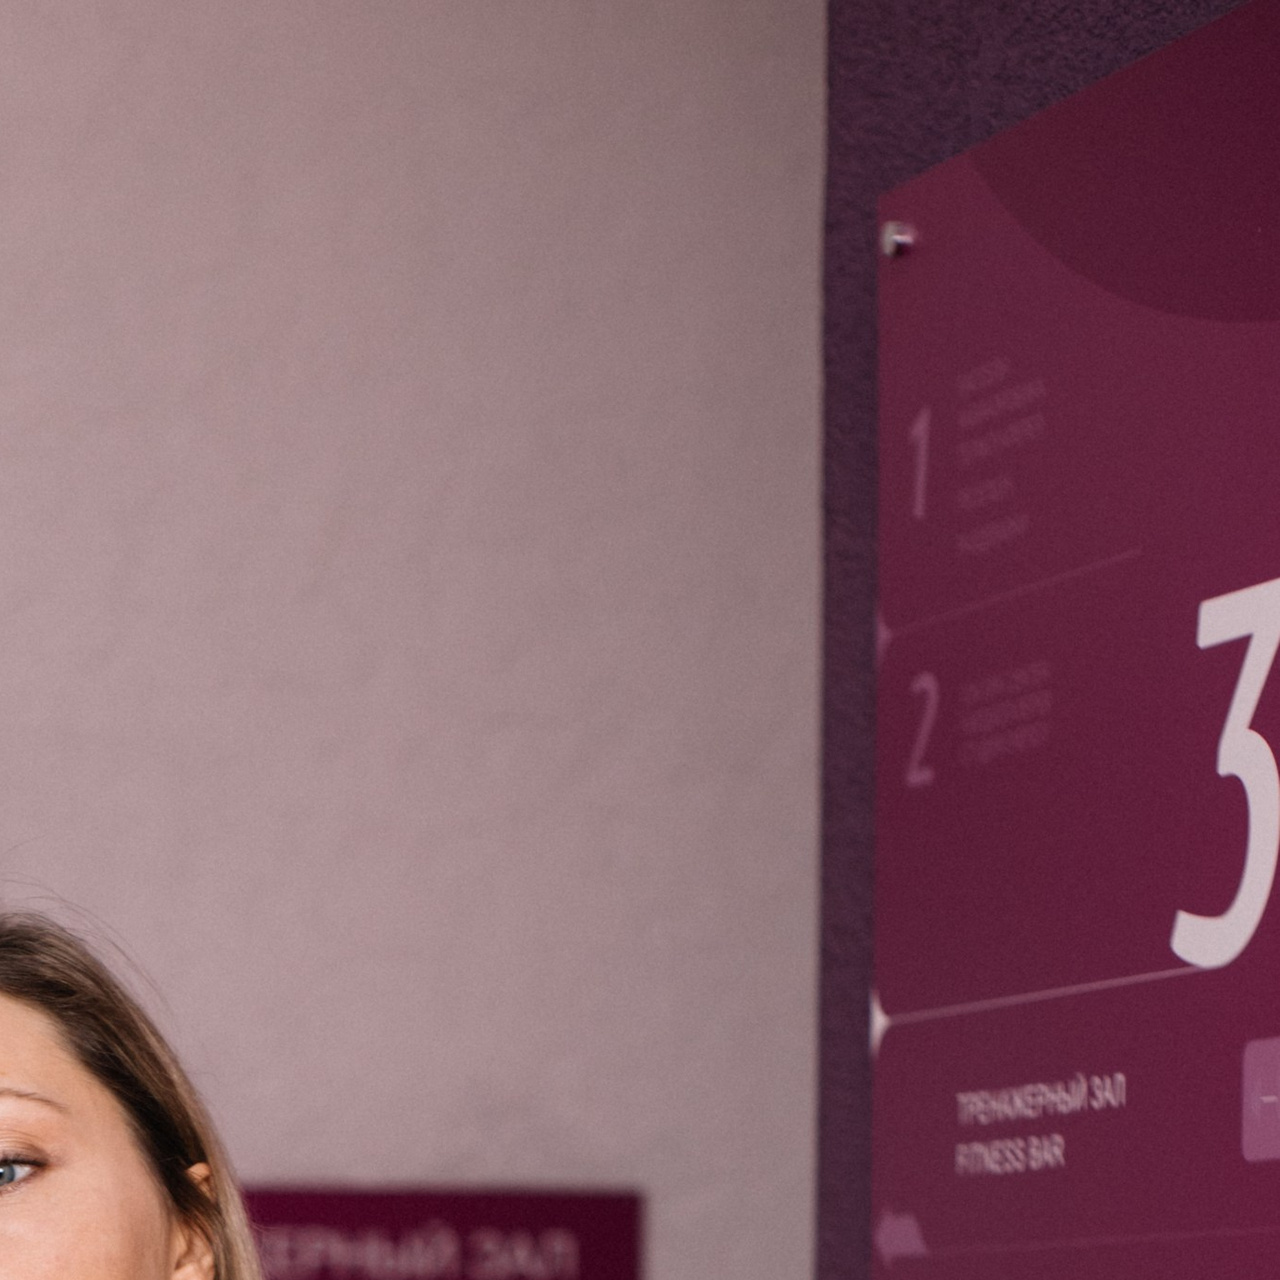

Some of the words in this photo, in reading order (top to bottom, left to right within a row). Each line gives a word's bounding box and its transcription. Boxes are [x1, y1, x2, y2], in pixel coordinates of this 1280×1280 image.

[908, 405, 932, 519] 1
[906, 671, 939, 788] 2
[1169, 577, 1280, 969] 3
[1089, 1072, 1127, 1111] ЗАЛ
[1027, 1133, 1065, 1171] BAR
